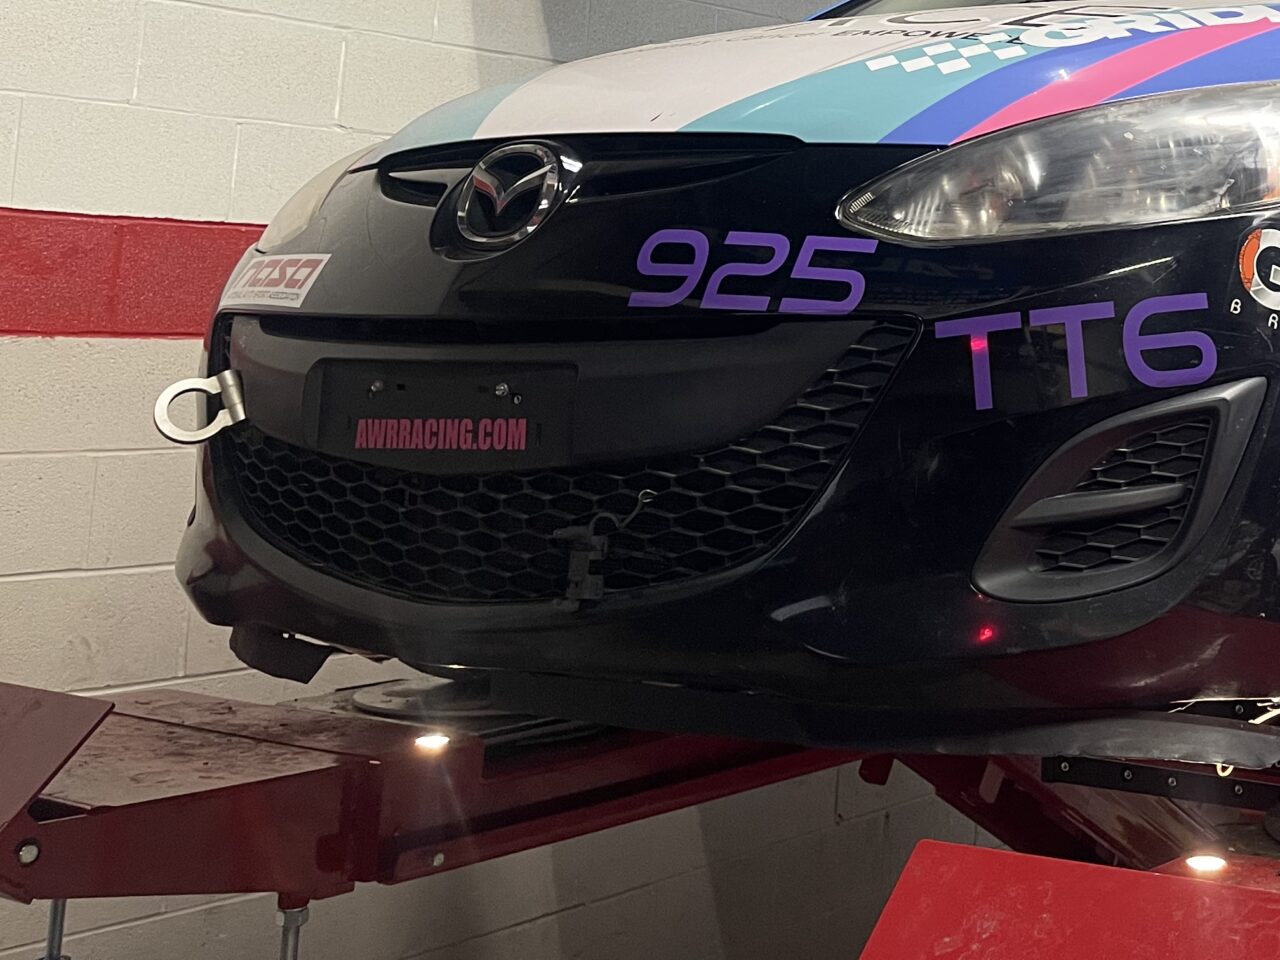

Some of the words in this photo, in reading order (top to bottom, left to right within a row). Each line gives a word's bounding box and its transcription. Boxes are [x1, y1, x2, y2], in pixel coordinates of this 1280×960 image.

[628, 228, 879, 315] 925
[934, 292, 1218, 411] TT6
[355, 418, 527, 450] AWRRACING.COM
